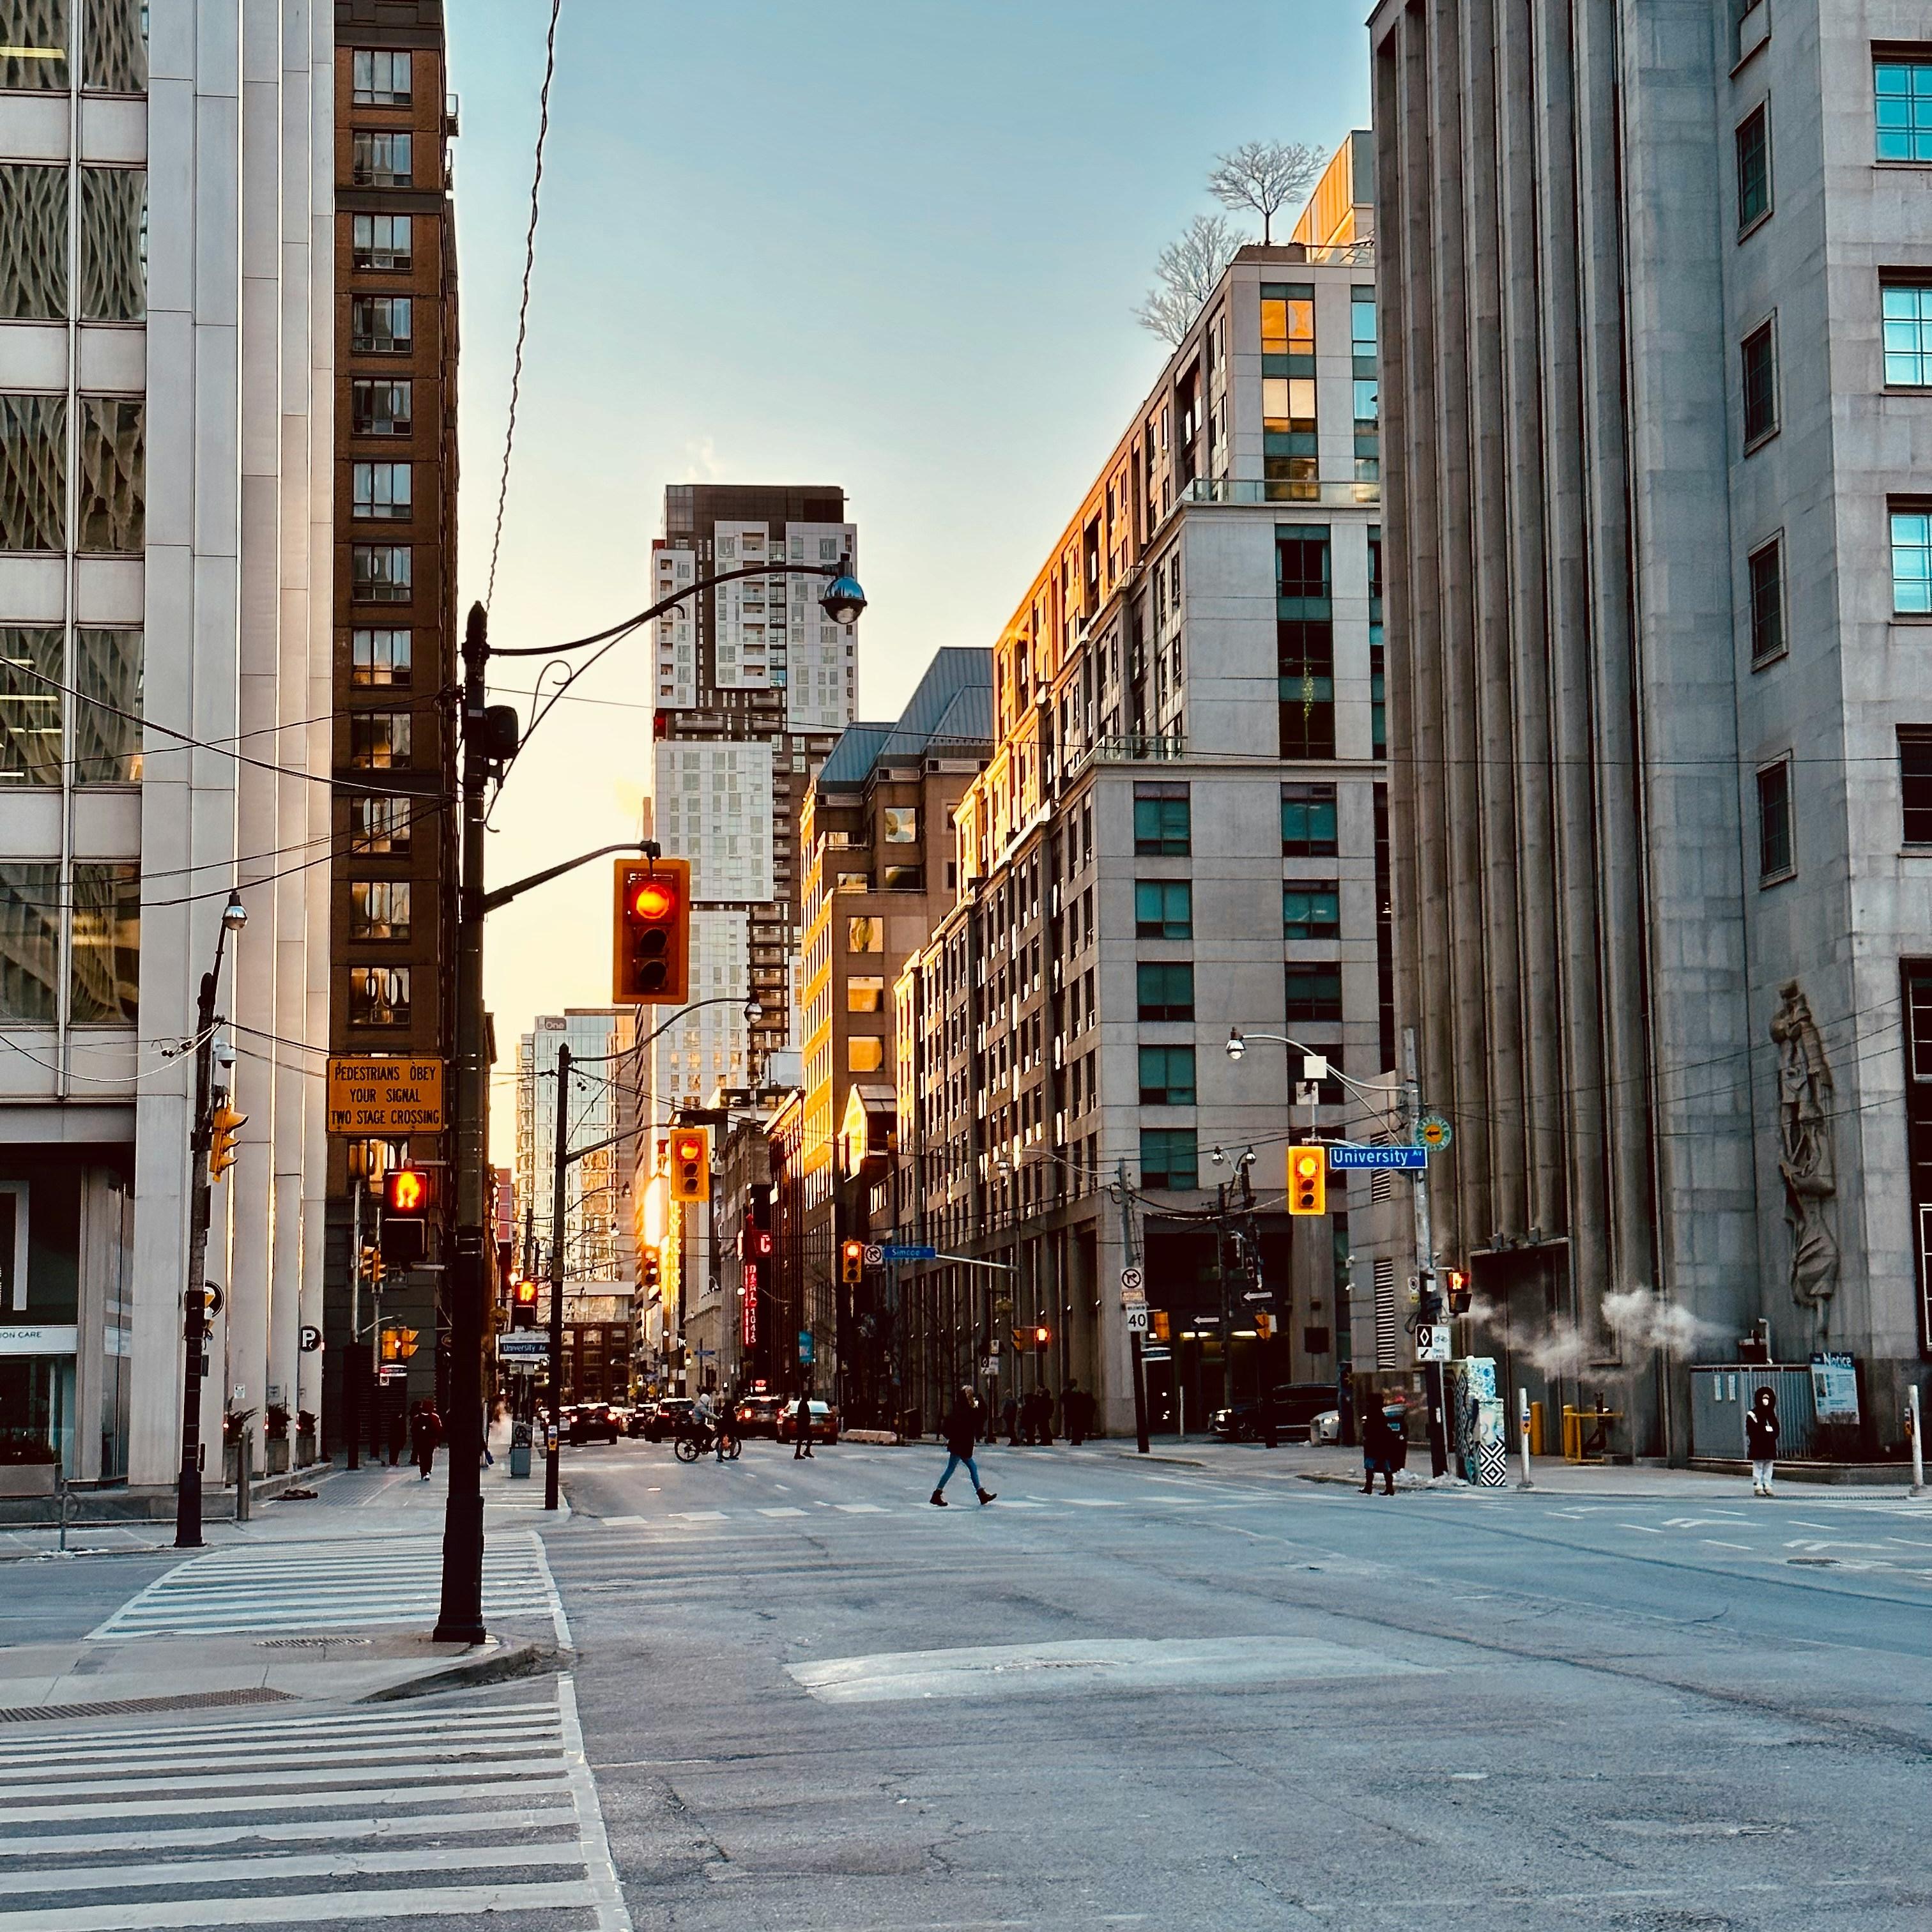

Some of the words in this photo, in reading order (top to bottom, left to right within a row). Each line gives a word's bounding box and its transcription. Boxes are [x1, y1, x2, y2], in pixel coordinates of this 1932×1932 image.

[334, 1066, 401, 1081] PEDESTRIANS
[410, 1066, 436, 1081] OBEY
[349, 1088, 377, 1103] YOUR
[386, 1088, 422, 1103] SIGNAL
[331, 1110, 352, 1124] TWO
[356, 1110, 386, 1124] STAGE
[390, 1109, 440, 1124] CROSSING
[1333, 1149, 1408, 1166] University
[892, 1248, 921, 1256] Simcoe
[1128, 1314, 1146, 1327] 40
[302, 1330, 316, 1347] P
[503, 1344, 535, 1353] University
[1823, 1352, 1852, 1367] Notice
